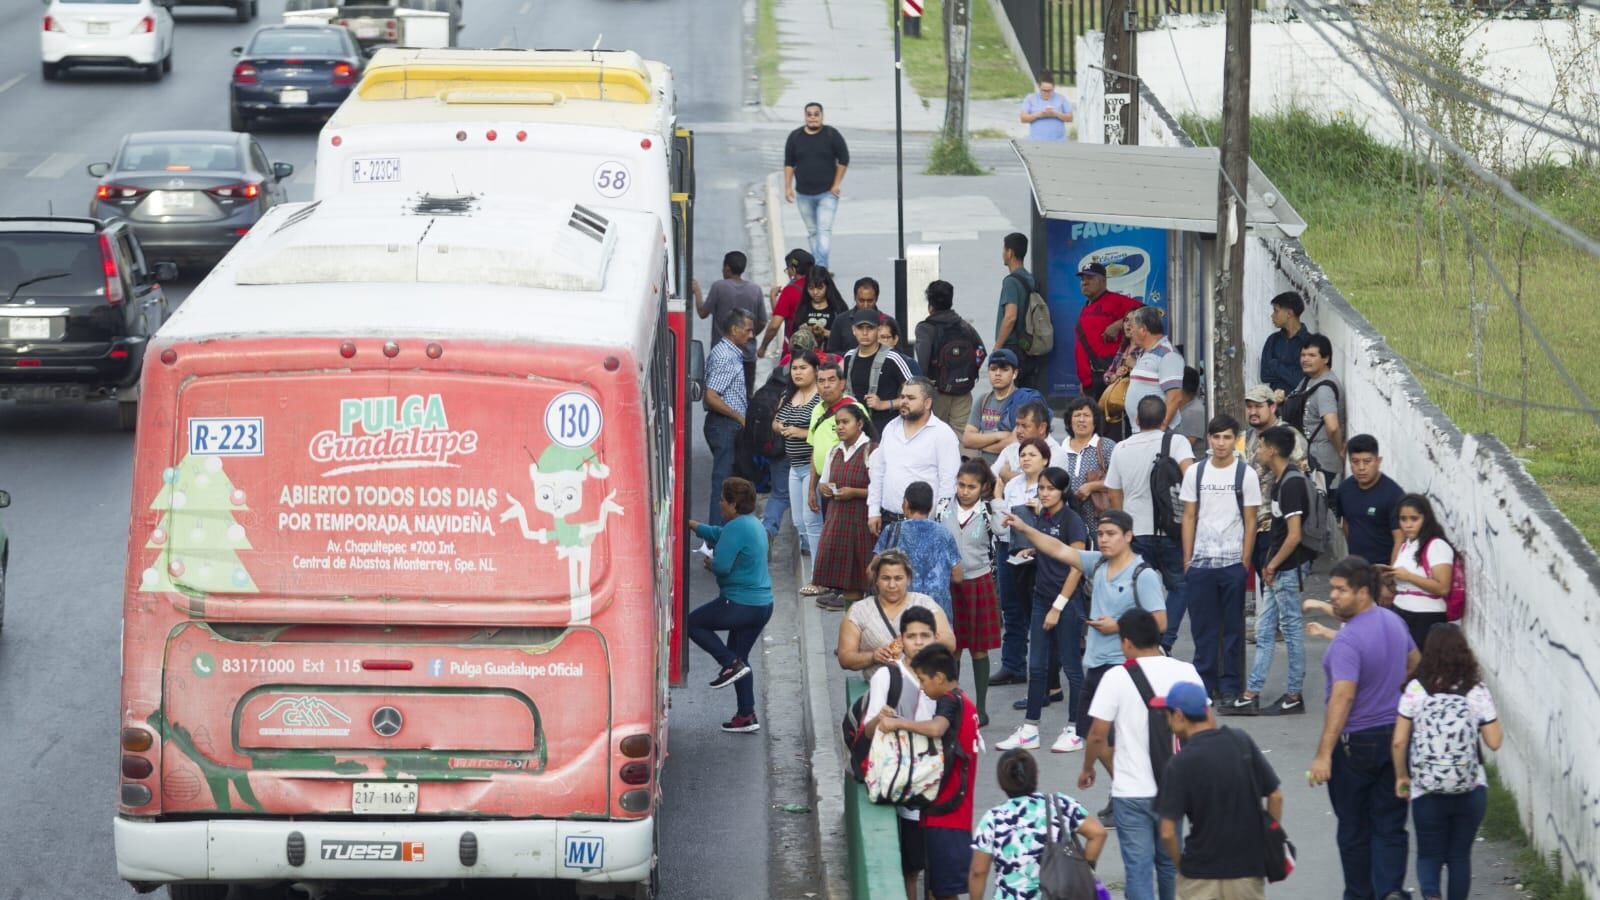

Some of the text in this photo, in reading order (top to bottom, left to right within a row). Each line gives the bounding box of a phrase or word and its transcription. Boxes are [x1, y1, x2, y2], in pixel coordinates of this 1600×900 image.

[598, 170, 626, 190] 58
[339, 394, 449, 435] PULGA
[559, 403, 589, 438] 130
[195, 424, 258, 450] R-223
[309, 427, 478, 462] Guadalupe
[280, 485, 498, 510] ABIERTO TODOS LOS DIAS
[279, 511, 495, 536] POR TEMPORADA NAVIDEÑA
[327, 539, 342, 553] Av.
[345, 539, 407, 555] Chapultepec
[439, 541, 457, 554] Int.
[293, 555, 330, 569] Central
[333, 556, 346, 569] de
[350, 556, 390, 570] Abastos
[455, 558, 476, 573] Gpe.
[222, 659, 361, 673] 83171000 Ext 115
[450, 661, 583, 678] Pulga Guadalupe Oficial
[569, 841, 600, 864] MV
